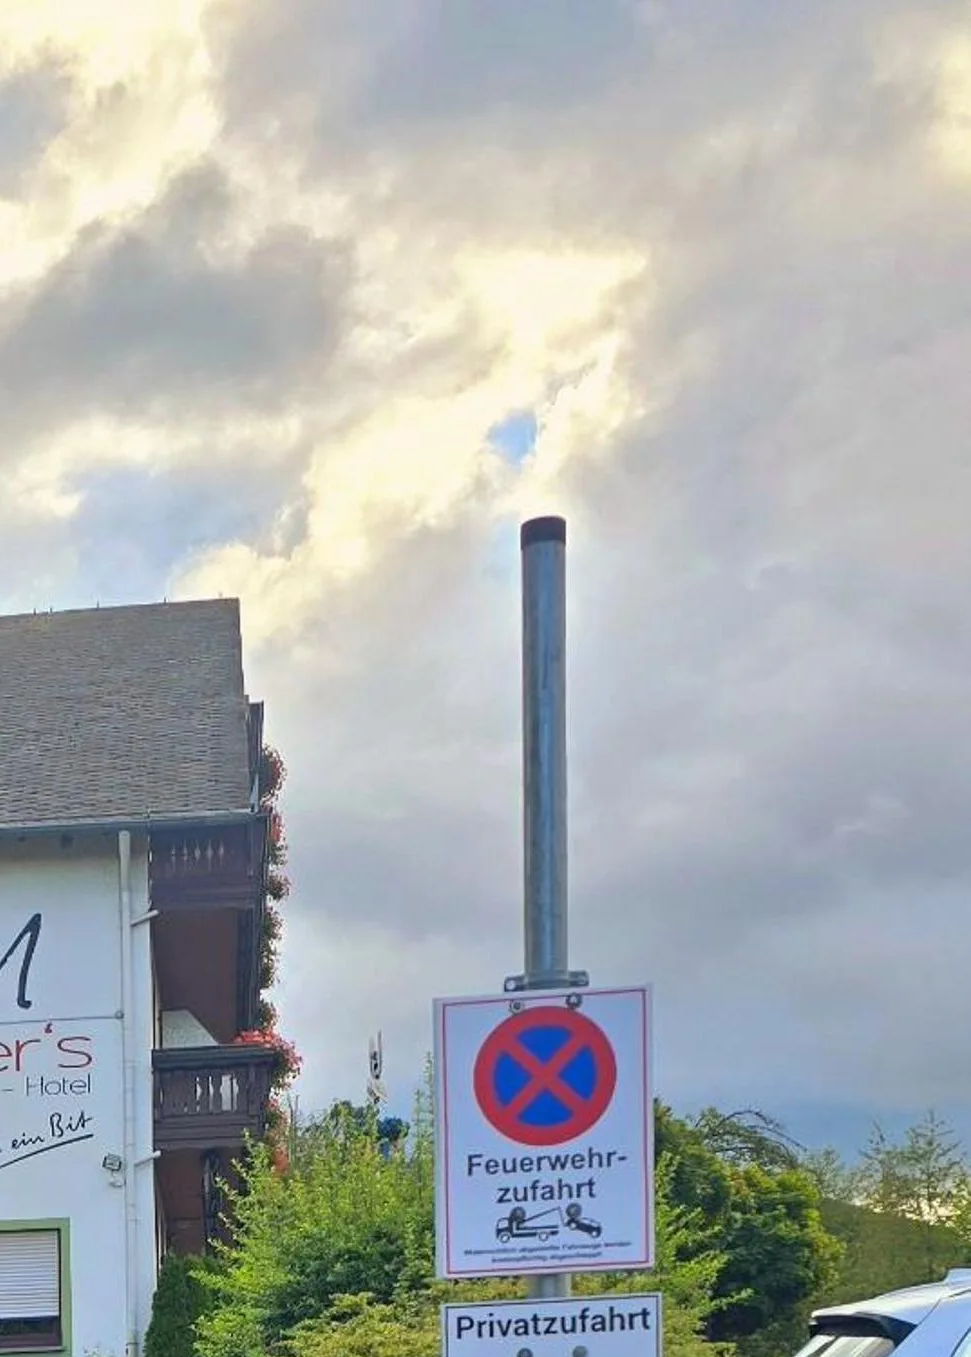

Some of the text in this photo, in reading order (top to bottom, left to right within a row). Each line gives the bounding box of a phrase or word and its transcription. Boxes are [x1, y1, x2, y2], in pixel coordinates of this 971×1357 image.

[25, 1073, 92, 1098] Hotel
[11, 1131, 45, 1149] ein
[49, 1109, 93, 1138] Bit
[466, 1147, 628, 1177] Feuerwehr-
[495, 1177, 597, 1205] zufahrt
[455, 1305, 652, 1340] Privatzufahrt
